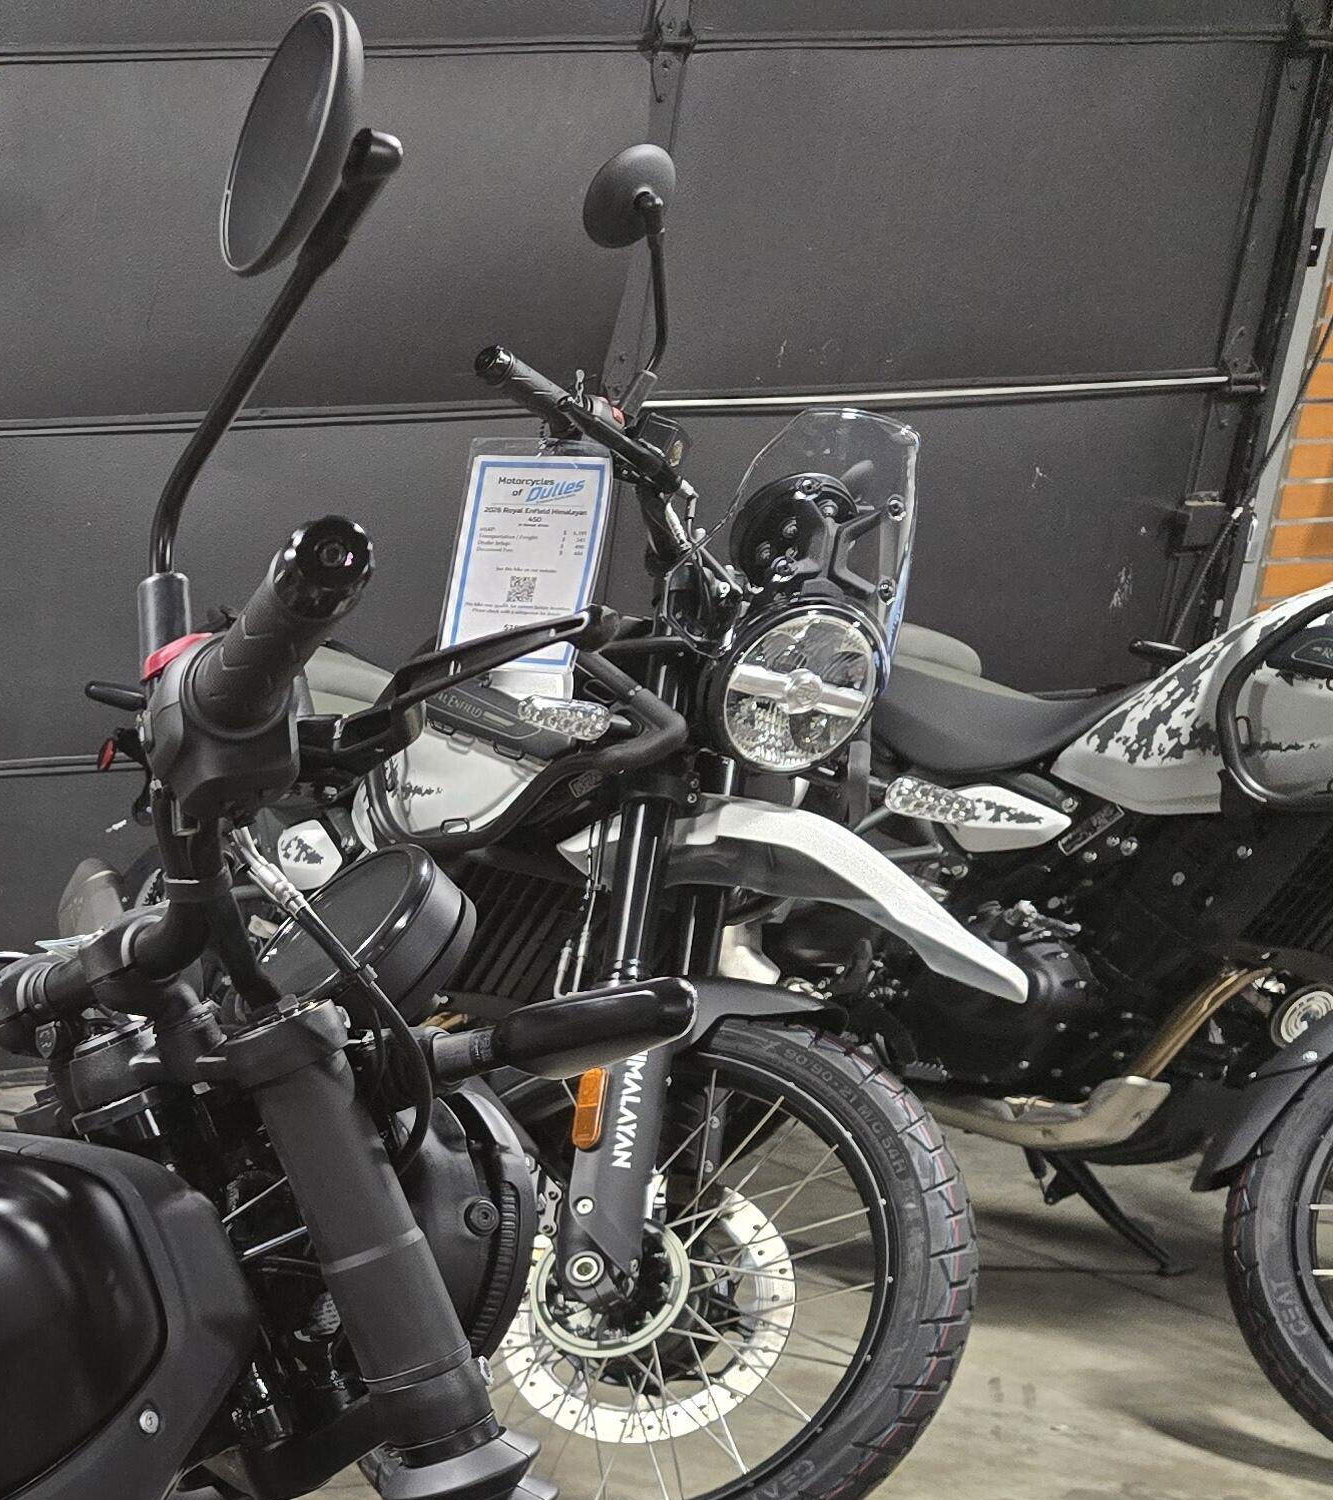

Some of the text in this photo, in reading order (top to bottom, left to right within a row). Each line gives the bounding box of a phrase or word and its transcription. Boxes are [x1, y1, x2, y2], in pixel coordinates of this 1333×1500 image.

[498, 477, 554, 486] Motorcycles
[525, 480, 585, 502] Dulles
[551, 508, 587, 516] Himalayan
